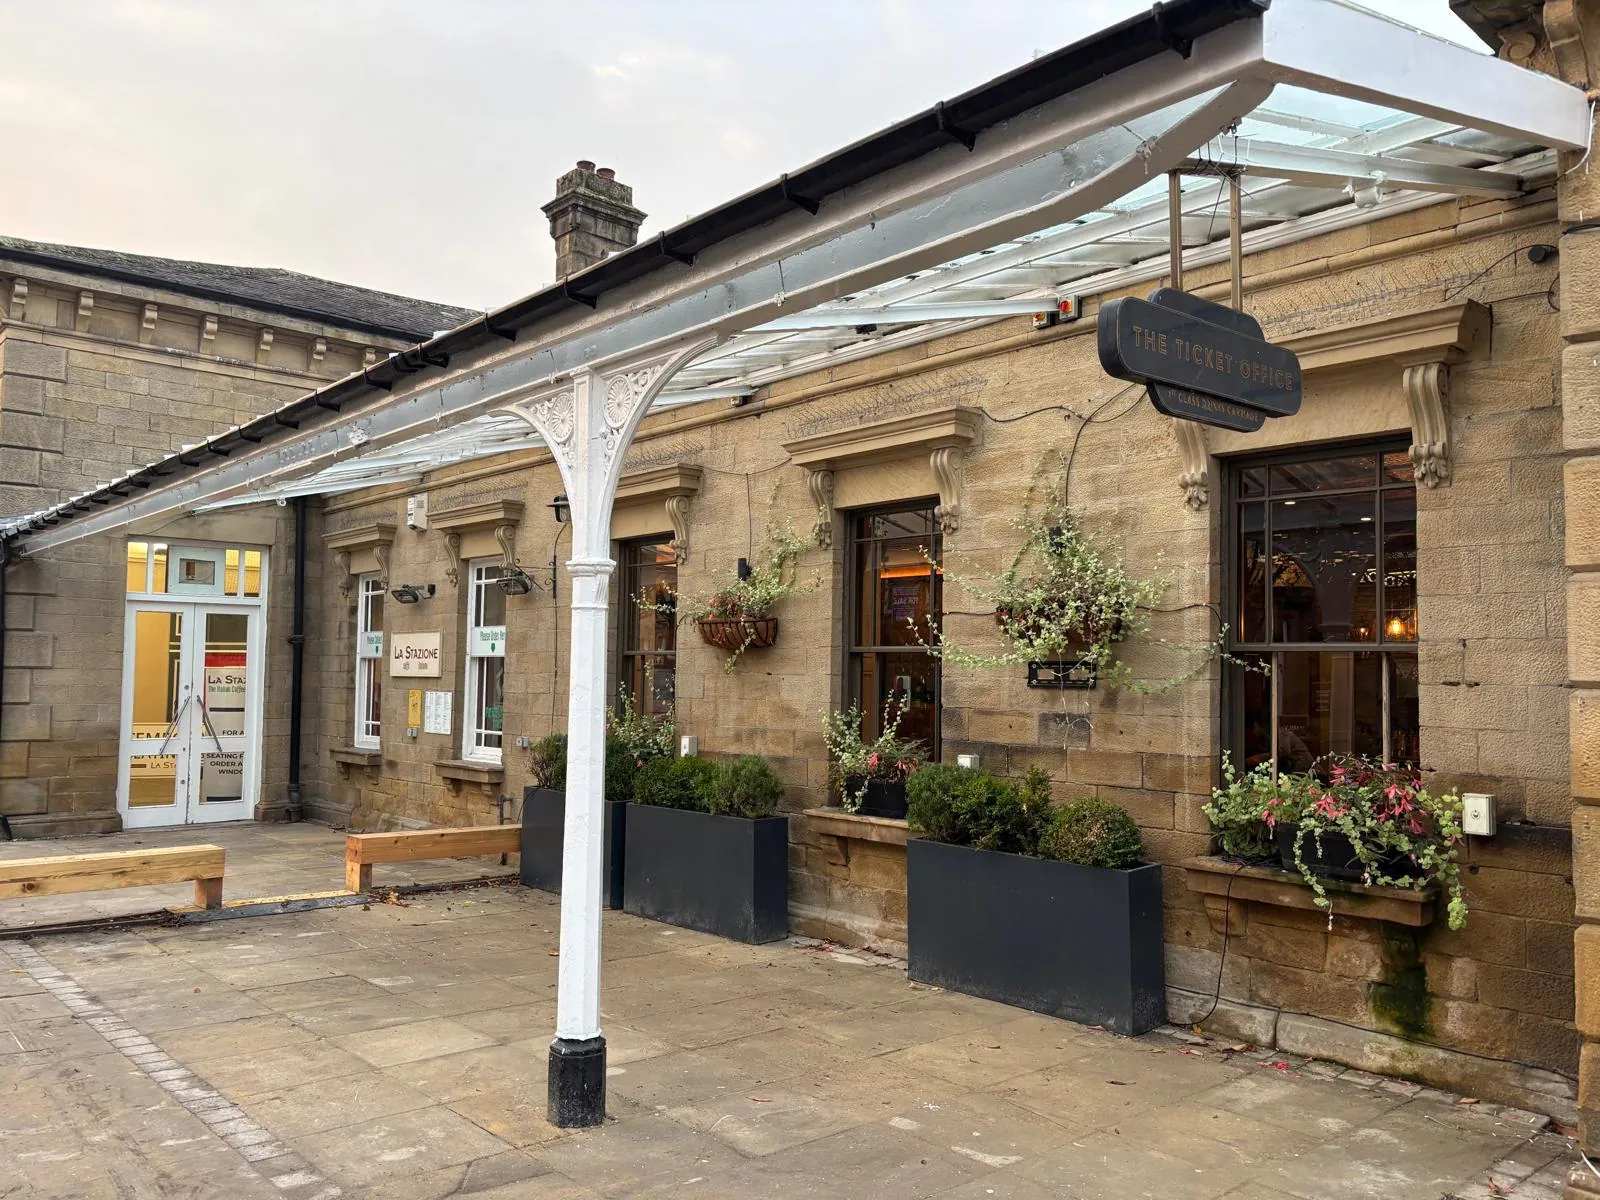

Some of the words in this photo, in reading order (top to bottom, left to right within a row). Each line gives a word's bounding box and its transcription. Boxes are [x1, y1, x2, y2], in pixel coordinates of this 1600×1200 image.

[1132, 325, 1167, 355] THE
[1175, 338, 1233, 374] TICKET
[1239, 359, 1293, 391] OFFICE
[394, 645, 403, 659] LA
[405, 645, 438, 660] STAZIONE
[208, 675, 222, 684] LA
[151, 761, 161, 769] LA
